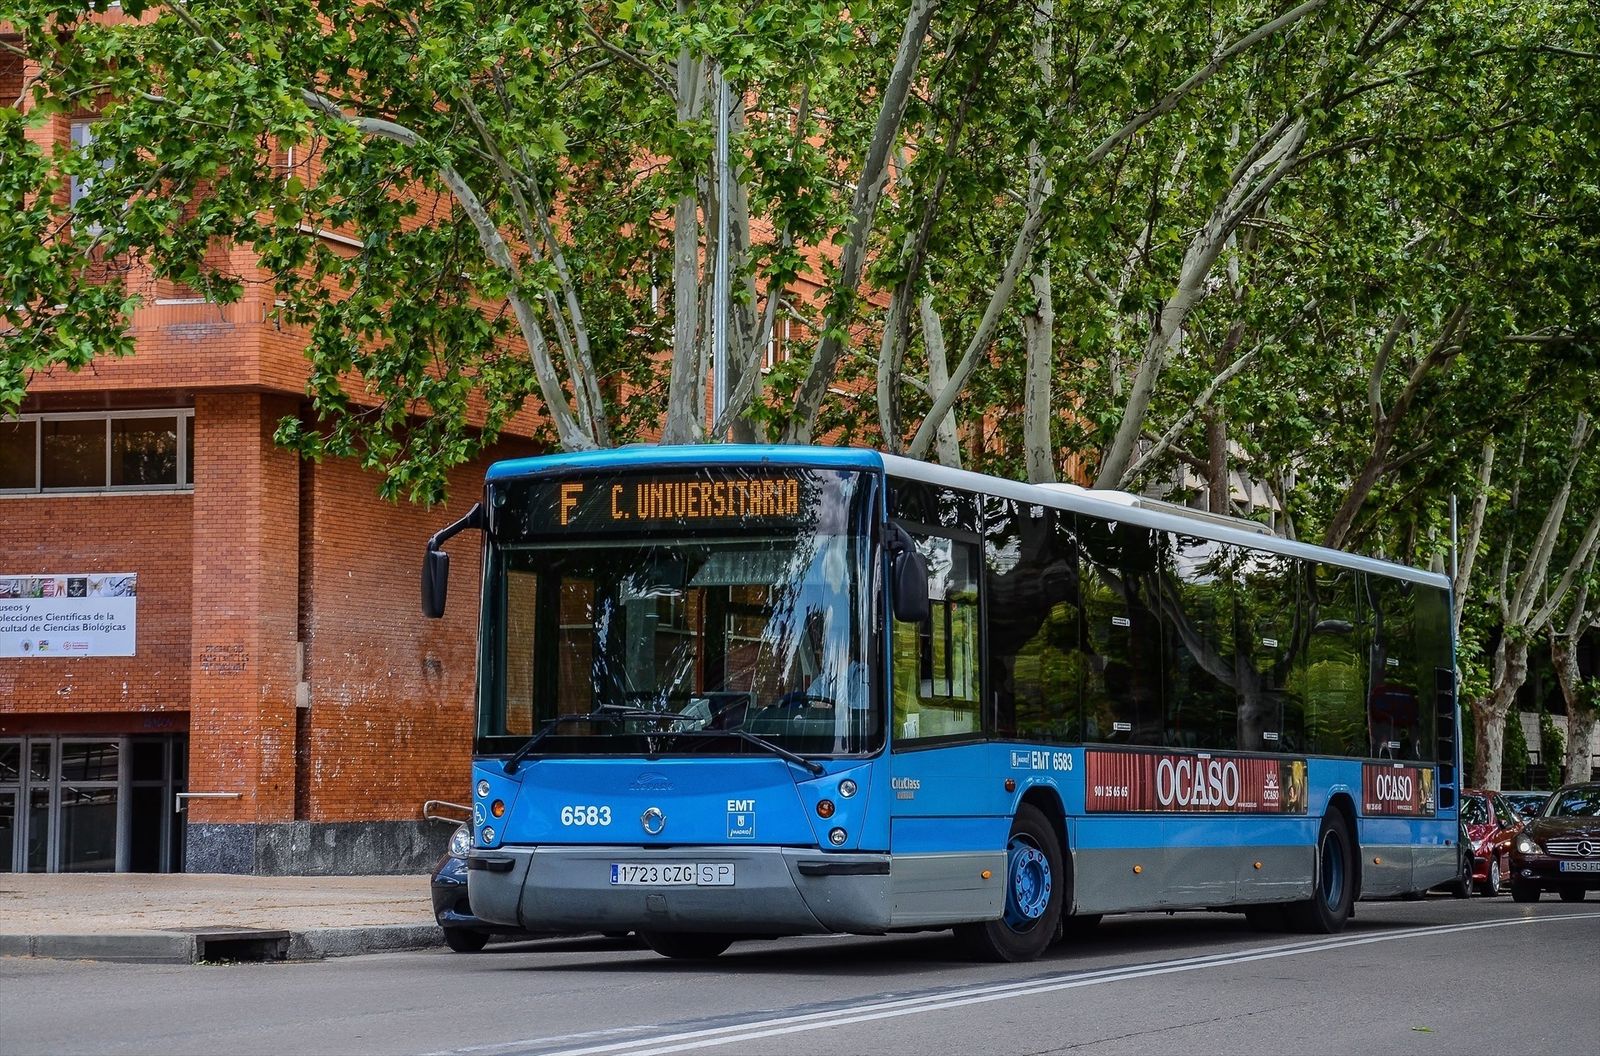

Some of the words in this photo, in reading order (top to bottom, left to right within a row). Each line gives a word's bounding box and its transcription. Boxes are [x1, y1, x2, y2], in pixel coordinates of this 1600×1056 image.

[560, 482, 584, 526] F
[611, 484, 630, 520] C.
[637, 479, 799, 519] UNIVERSITARIA
[25, 603, 31, 613] y
[0, 613, 43, 622] olecciones
[45, 612, 91, 622] Científicas
[94, 612, 104, 621] de
[106, 612, 114, 621] la
[0, 624, 28, 633] cultad
[30, 624, 41, 632] de
[43, 623, 80, 632] Ciencias
[82, 623, 126, 633] Biológicas
[1032, 751, 1050, 771] EMT
[1053, 752, 1073, 772] 6583
[1156, 758, 1239, 807] OCASO
[1376, 774, 1413, 802] OCASO
[1263, 790, 1279, 800] OCASO
[727, 800, 755, 812] EMT
[560, 805, 612, 826] 6583
[1567, 862, 1587, 871] 1559
[1590, 862, 1600, 871] FD
[621, 866, 659, 882] 1723
[663, 866, 692, 882] CZG
